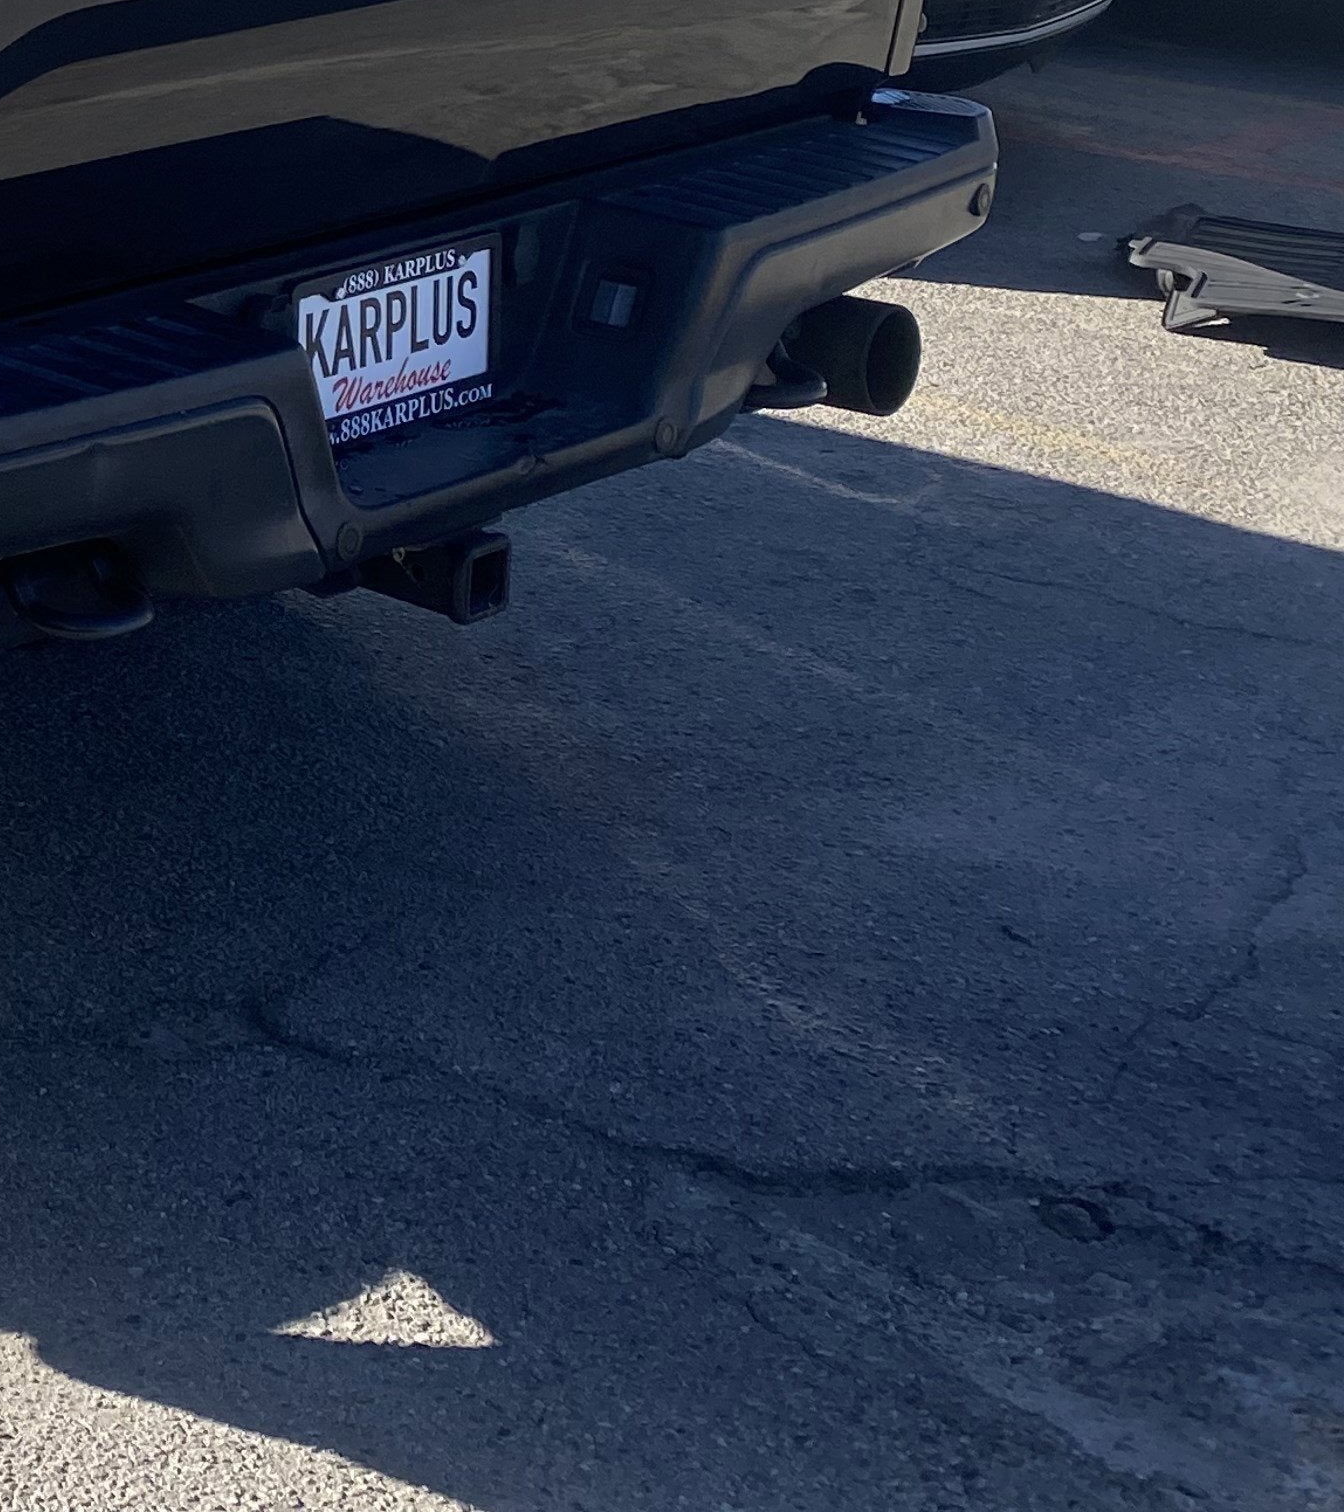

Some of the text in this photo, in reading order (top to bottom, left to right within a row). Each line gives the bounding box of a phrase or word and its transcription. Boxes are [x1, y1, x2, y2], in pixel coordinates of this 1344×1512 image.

[342, 249, 456, 292] (888) KARPLUS
[306, 271, 478, 378] KARPLUS
[332, 357, 452, 413] Warehouse
